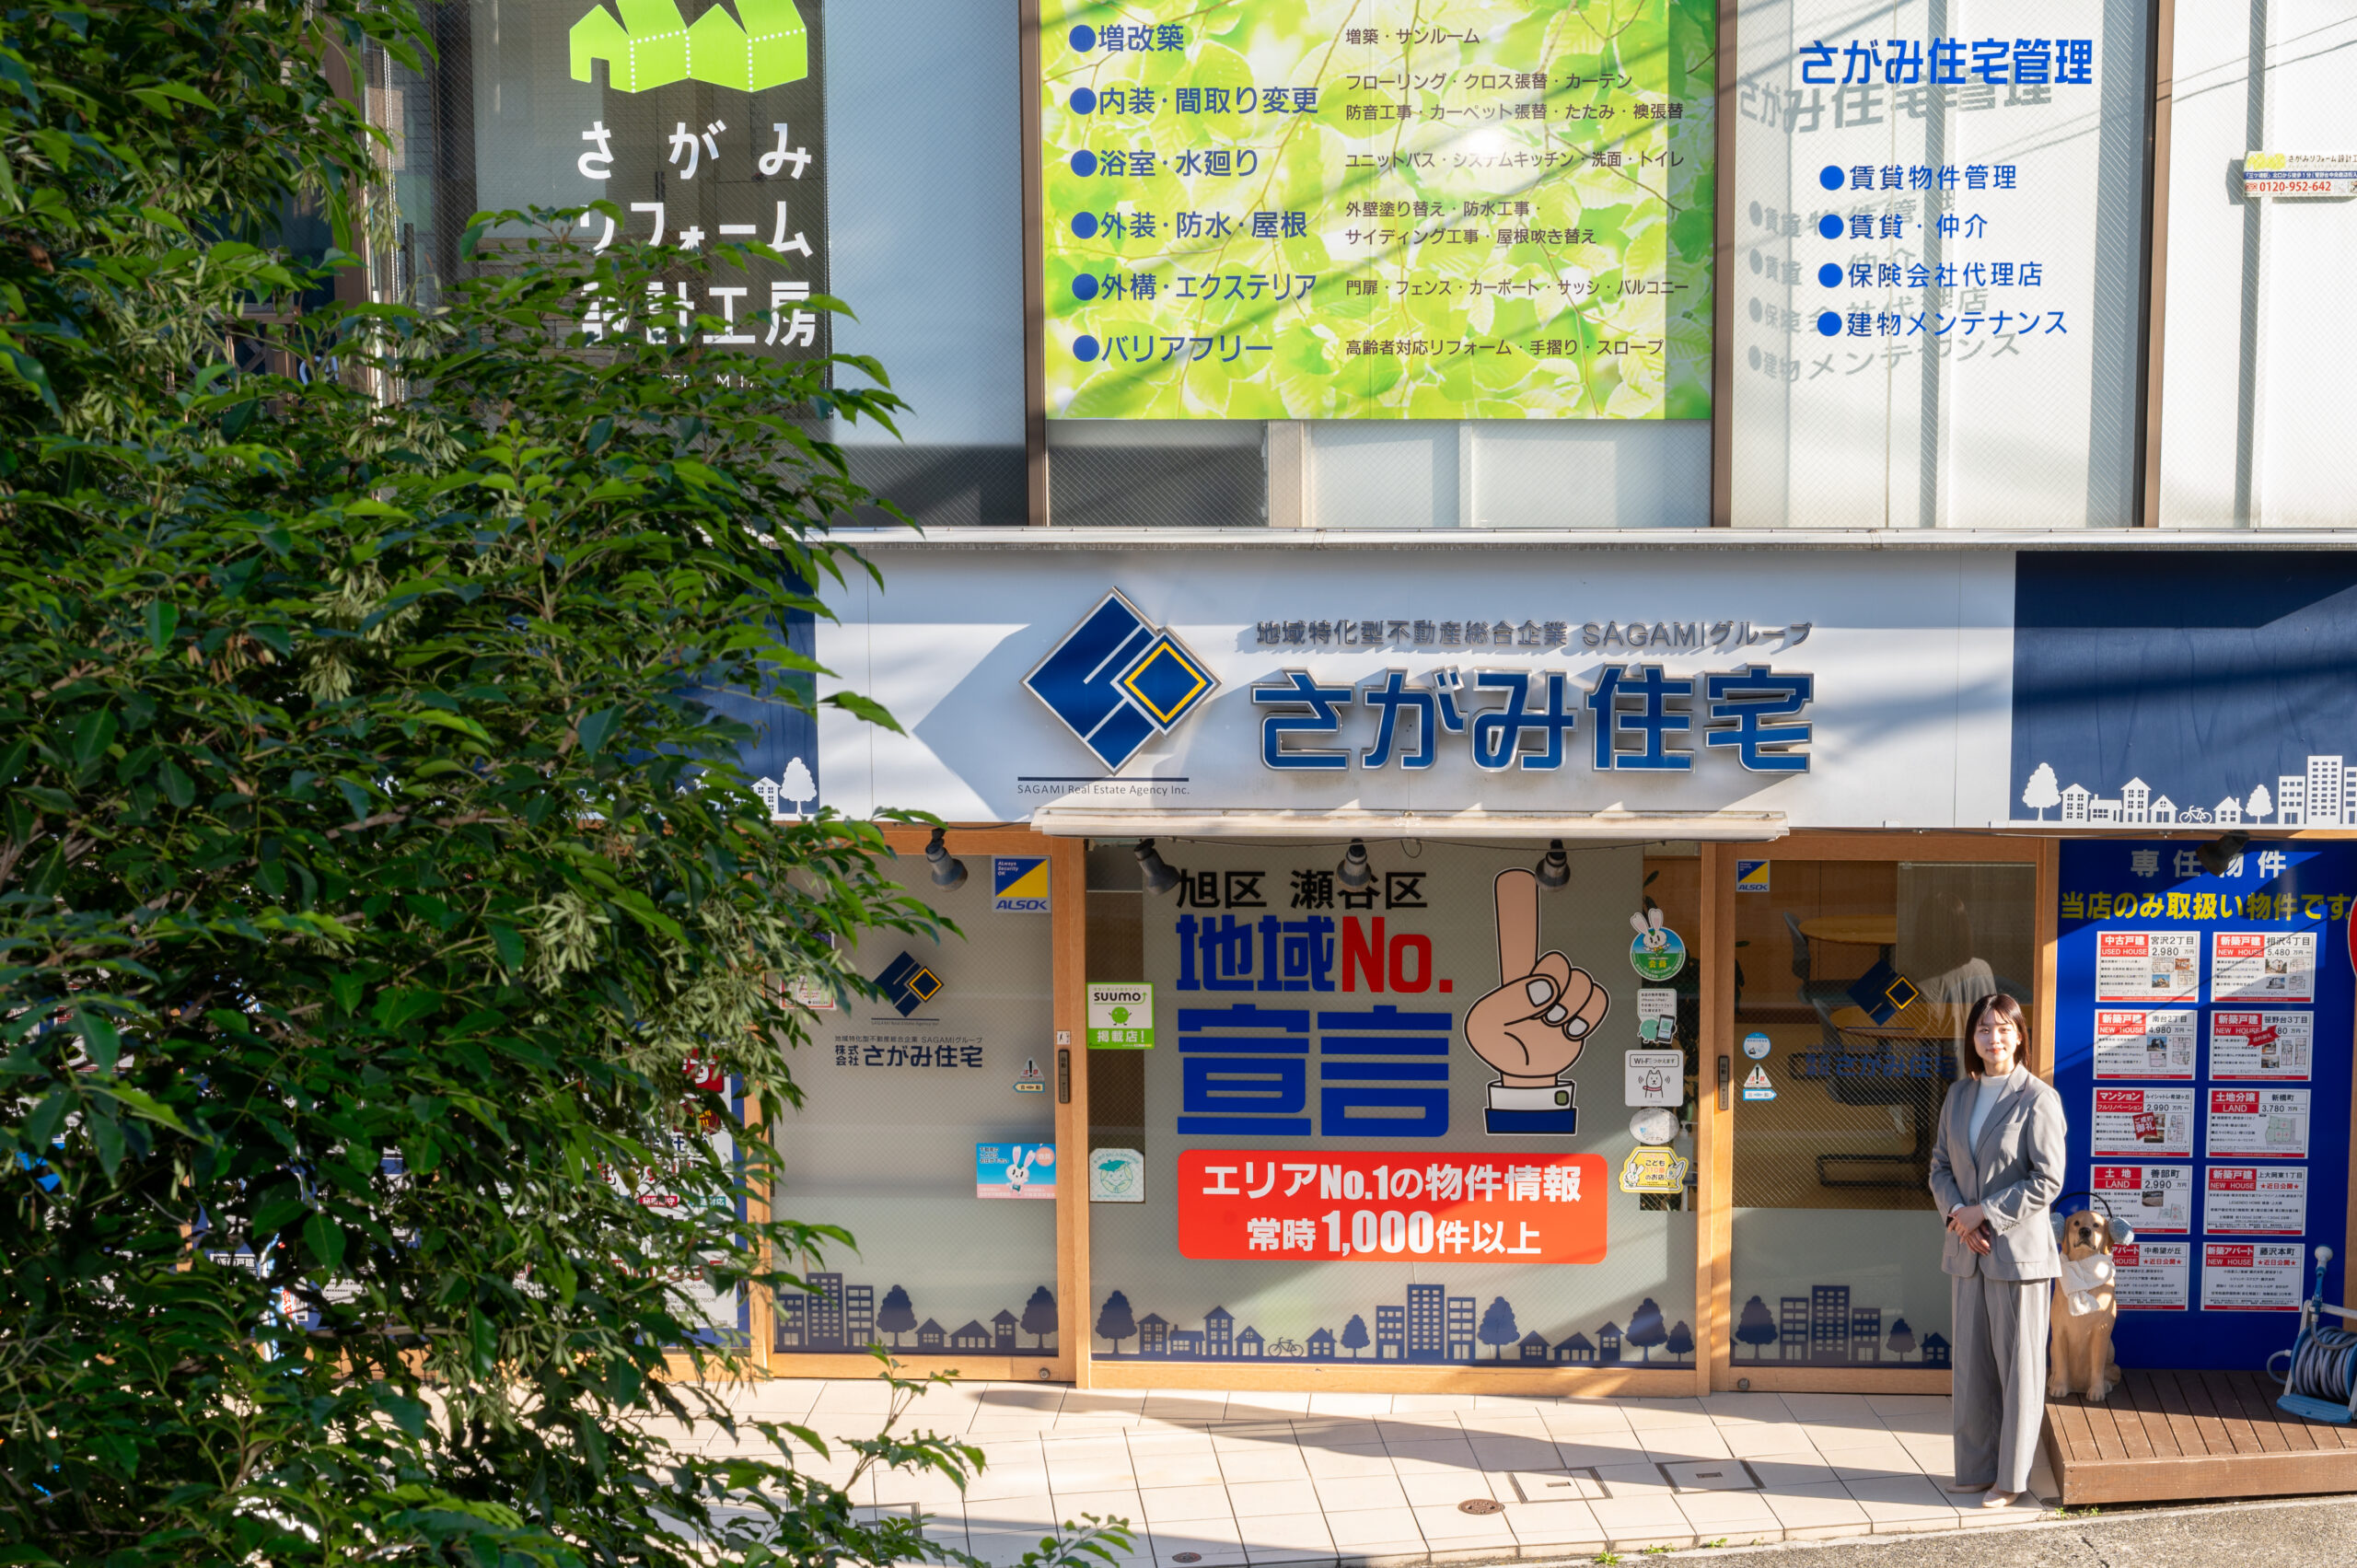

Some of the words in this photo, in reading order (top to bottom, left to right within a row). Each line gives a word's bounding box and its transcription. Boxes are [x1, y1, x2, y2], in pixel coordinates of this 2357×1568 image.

[1098, 24, 1184, 52] 増改築
[1345, 28, 1480, 45] 増築・サンルーム
[1799, 38, 2093, 85] さがみ住宅管理
[1345, 73, 1633, 90] フローリング・クロス張替・カーテン
[1099, 87, 1318, 115] 内装・間取り変更
[577, 121, 812, 180] さがみ
[1099, 149, 1259, 177] 浴室・水廻り
[1344, 151, 1685, 168] ユニットバス・システムキッチン・洗面・トイレ
[1849, 165, 2017, 191] 賃貸物件管理
[2259, 181, 2332, 192] 0120-952-642
[1100, 211, 1307, 239] 外装・防水・屋根
[1345, 228, 1597, 245] サイディング工事・屋根吹き替え
[1849, 214, 1989, 240] 賃貸・仲介
[1101, 273, 1317, 301] 外構・エクステリア
[1848, 261, 2043, 288] 保険会社代理店
[1345, 280, 1689, 296] 門扉・フェンス・カーポート・サッシ・バルコニー
[1846, 310, 2068, 337] 建物メンテナンス
[1101, 335, 1273, 363] バリアフリー
[1345, 339, 1664, 356] 高齢者対応リフォーム・手摺り・スロープ
[1256, 620, 1568, 645] 地域特化型不動産総合企業
[1582, 621, 1814, 647] SAGAMIグループ
[1250, 662, 1816, 773] さがみ住宅
[1017, 784, 1064, 795] SAGAMI
[1068, 784, 1090, 795] Real
[1094, 784, 1126, 795] Estate
[1129, 784, 1167, 796] Agency
[1171, 785, 1190, 795] Inc.
[1176, 869, 1267, 910] 旭区
[1289, 869, 1428, 911] 瀬谷区
[995, 900, 1048, 911] ALSOK
[2105, 935, 2145, 946] 中古戸建
[2218, 1015, 2258, 1025] 新築戸建
[863, 1045, 983, 1068] さがみ住宅
[1177, 1004, 1453, 1137] 宣言
[2099, 1092, 2141, 1101] マンション
[2215, 1092, 2256, 1102] 土地分譲
[1202, 1162, 1582, 1202] エリアNo.1の物件情報
[2105, 1168, 2131, 1179] 土地
[2212, 1169, 2253, 1179] 新築戸建
[1247, 1210, 1542, 1258] 常時1,000件以上
